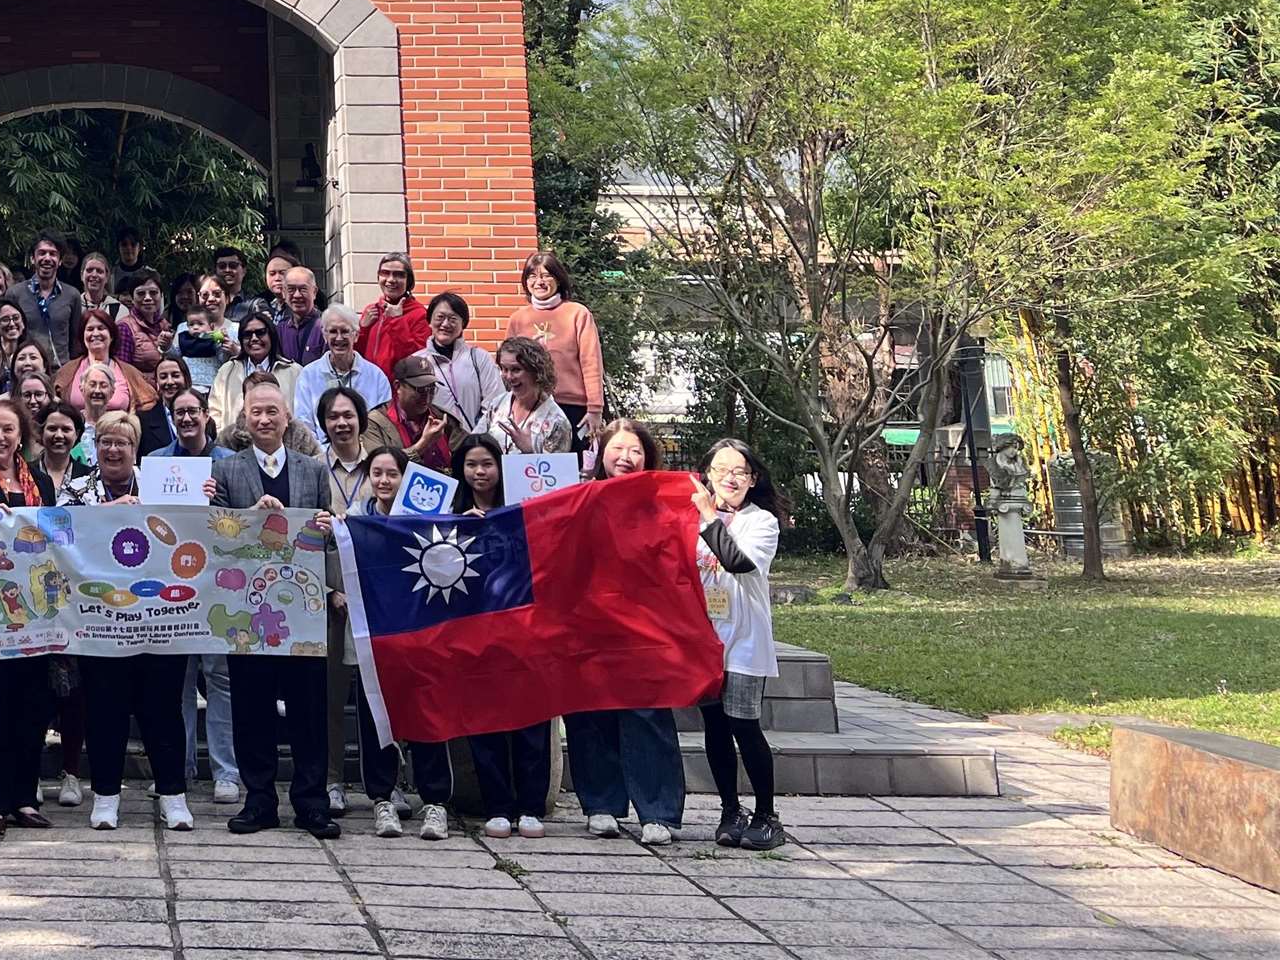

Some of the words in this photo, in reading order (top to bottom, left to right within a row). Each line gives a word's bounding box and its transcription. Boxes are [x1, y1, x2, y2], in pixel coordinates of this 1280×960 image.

[80, 604, 112, 618] Let's
[115, 612, 142, 622] Play
[146, 601, 200, 617] Together
[92, 632, 134, 640] International
